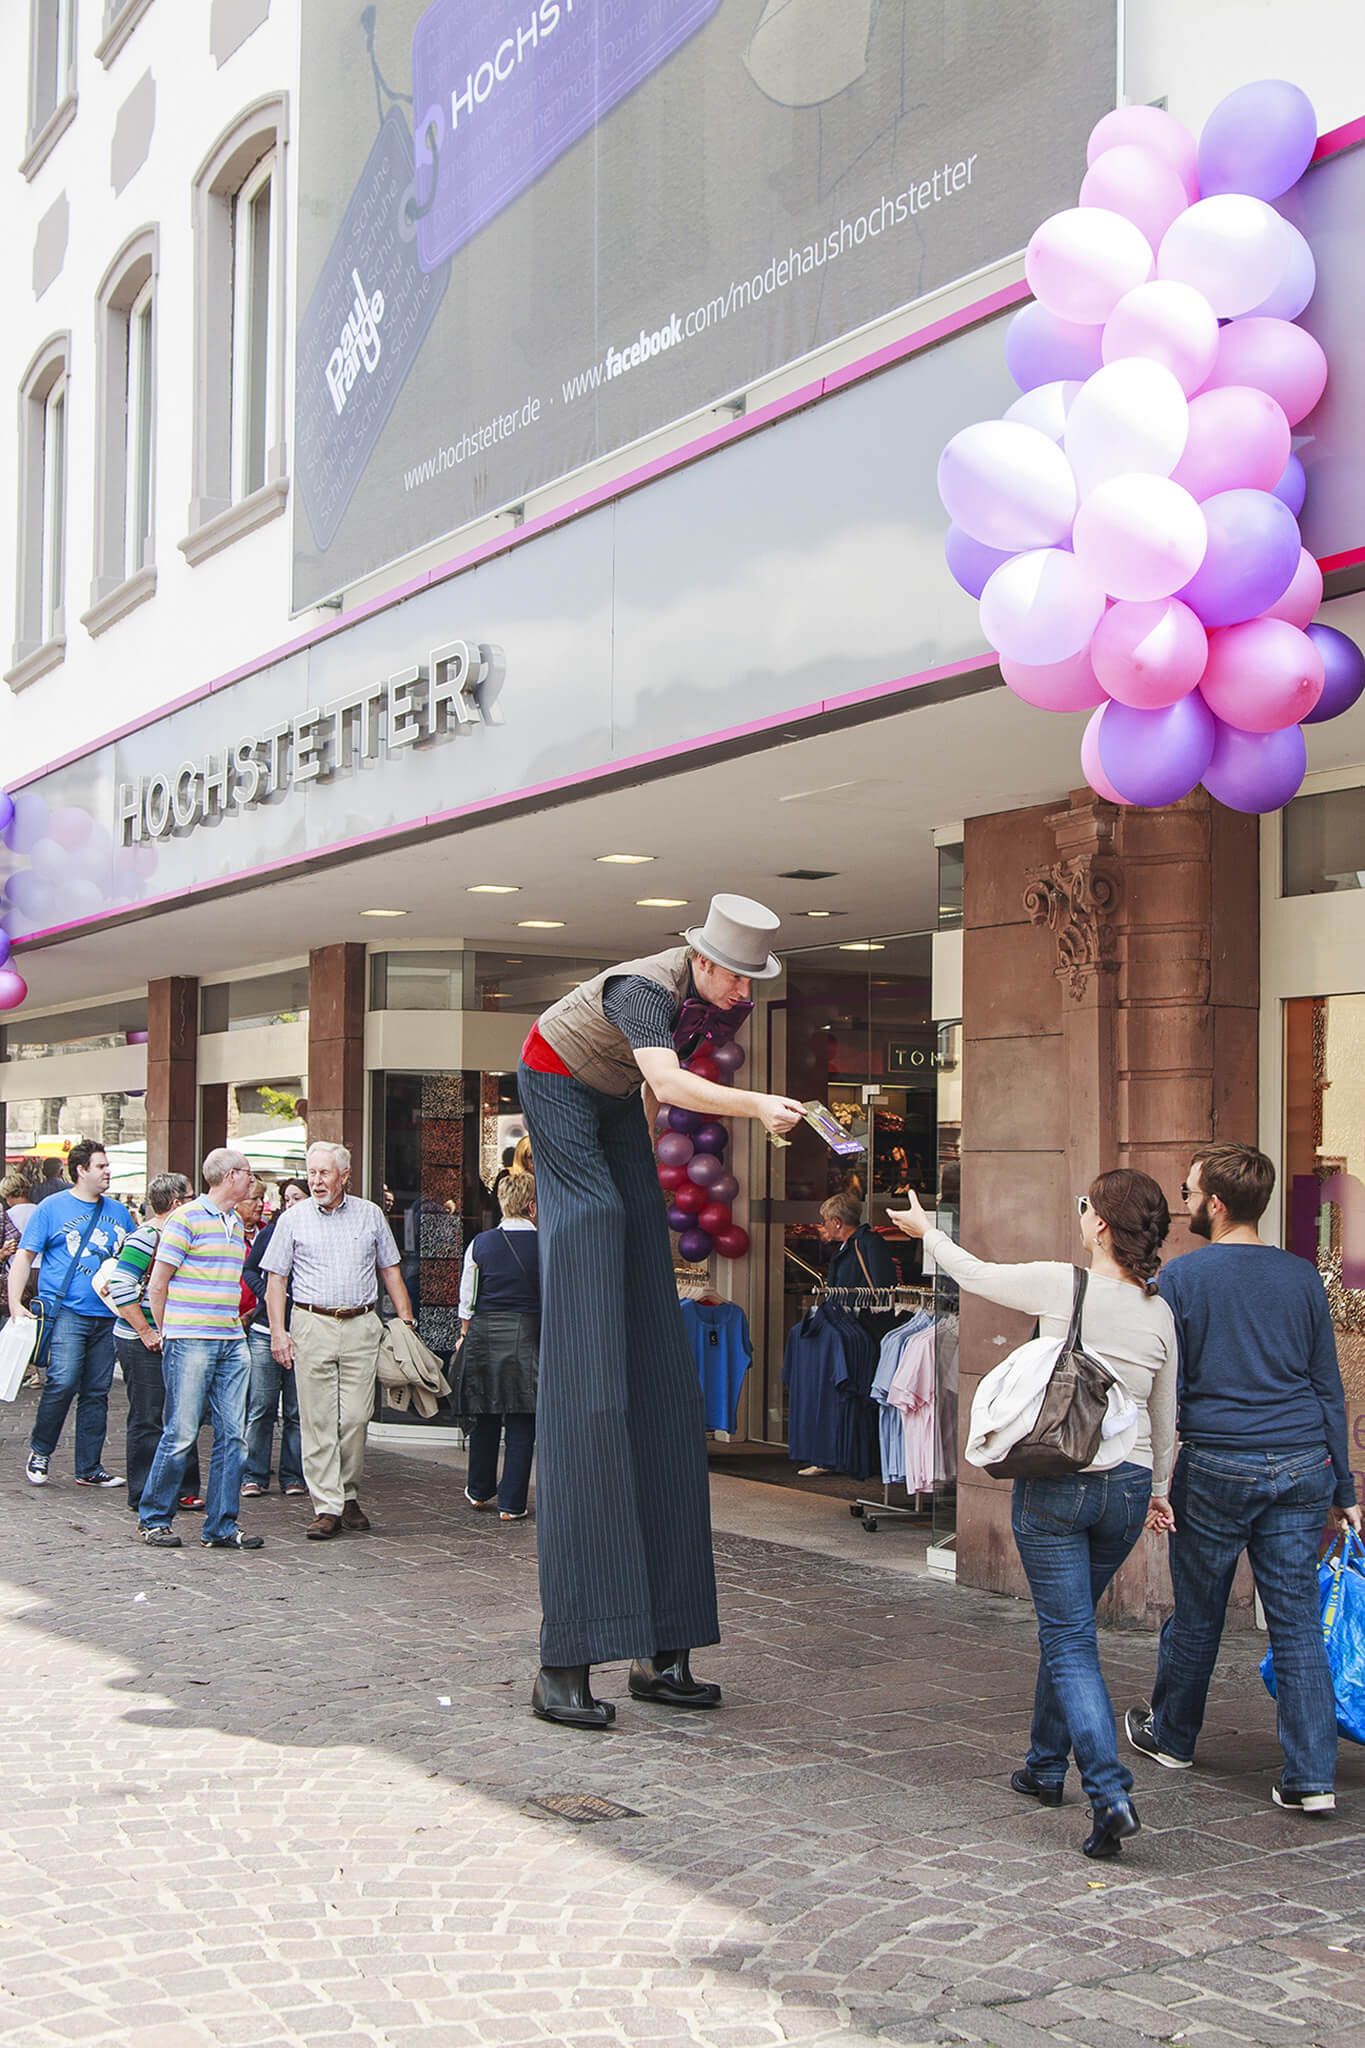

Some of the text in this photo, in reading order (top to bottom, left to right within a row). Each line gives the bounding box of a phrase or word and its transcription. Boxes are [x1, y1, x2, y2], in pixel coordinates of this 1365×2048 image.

[451, 0, 573, 129] HOCHS
[402, 395, 541, 491] www.hochstetter.de
[561, 153, 978, 404] www.facebook.com/modehaushochstetter
[119, 639, 482, 847] HOCHSTETTER
